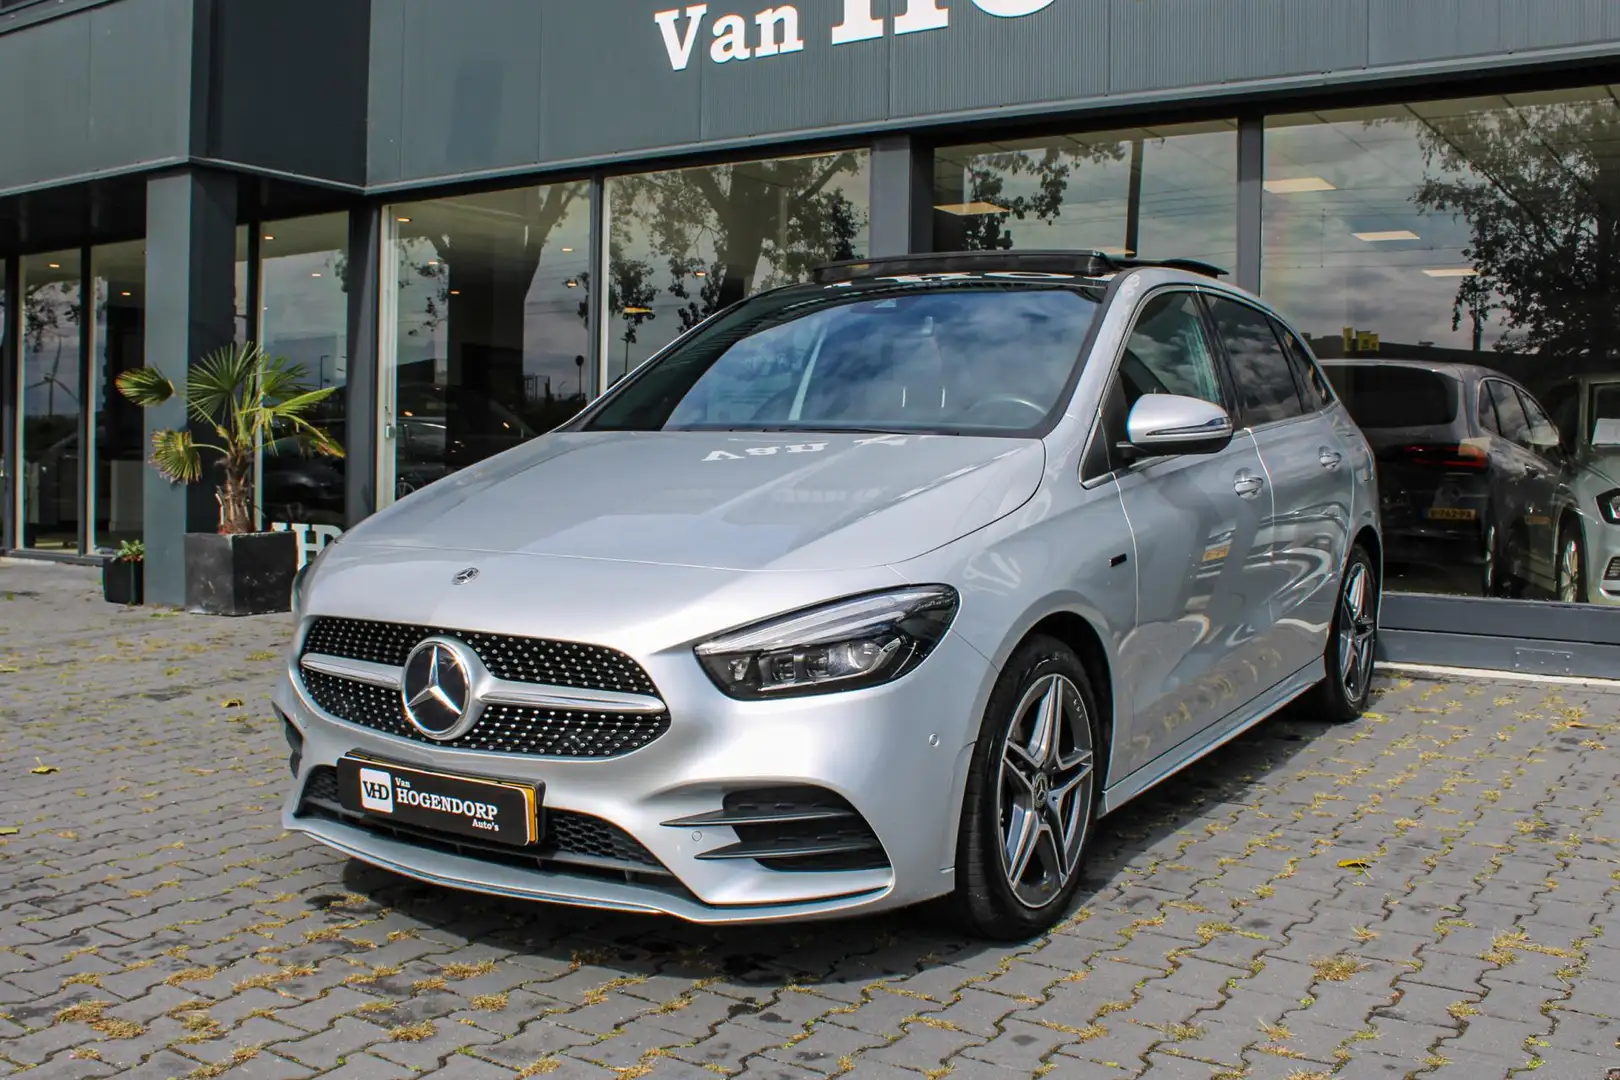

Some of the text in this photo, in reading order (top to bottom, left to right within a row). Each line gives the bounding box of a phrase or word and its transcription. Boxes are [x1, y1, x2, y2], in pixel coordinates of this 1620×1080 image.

[654, 3, 804, 72] Van
[362, 780, 389, 801] VHD
[395, 777, 410, 788] Van
[396, 787, 498, 820] HOGENDORP
[472, 818, 499, 831] Auto's
